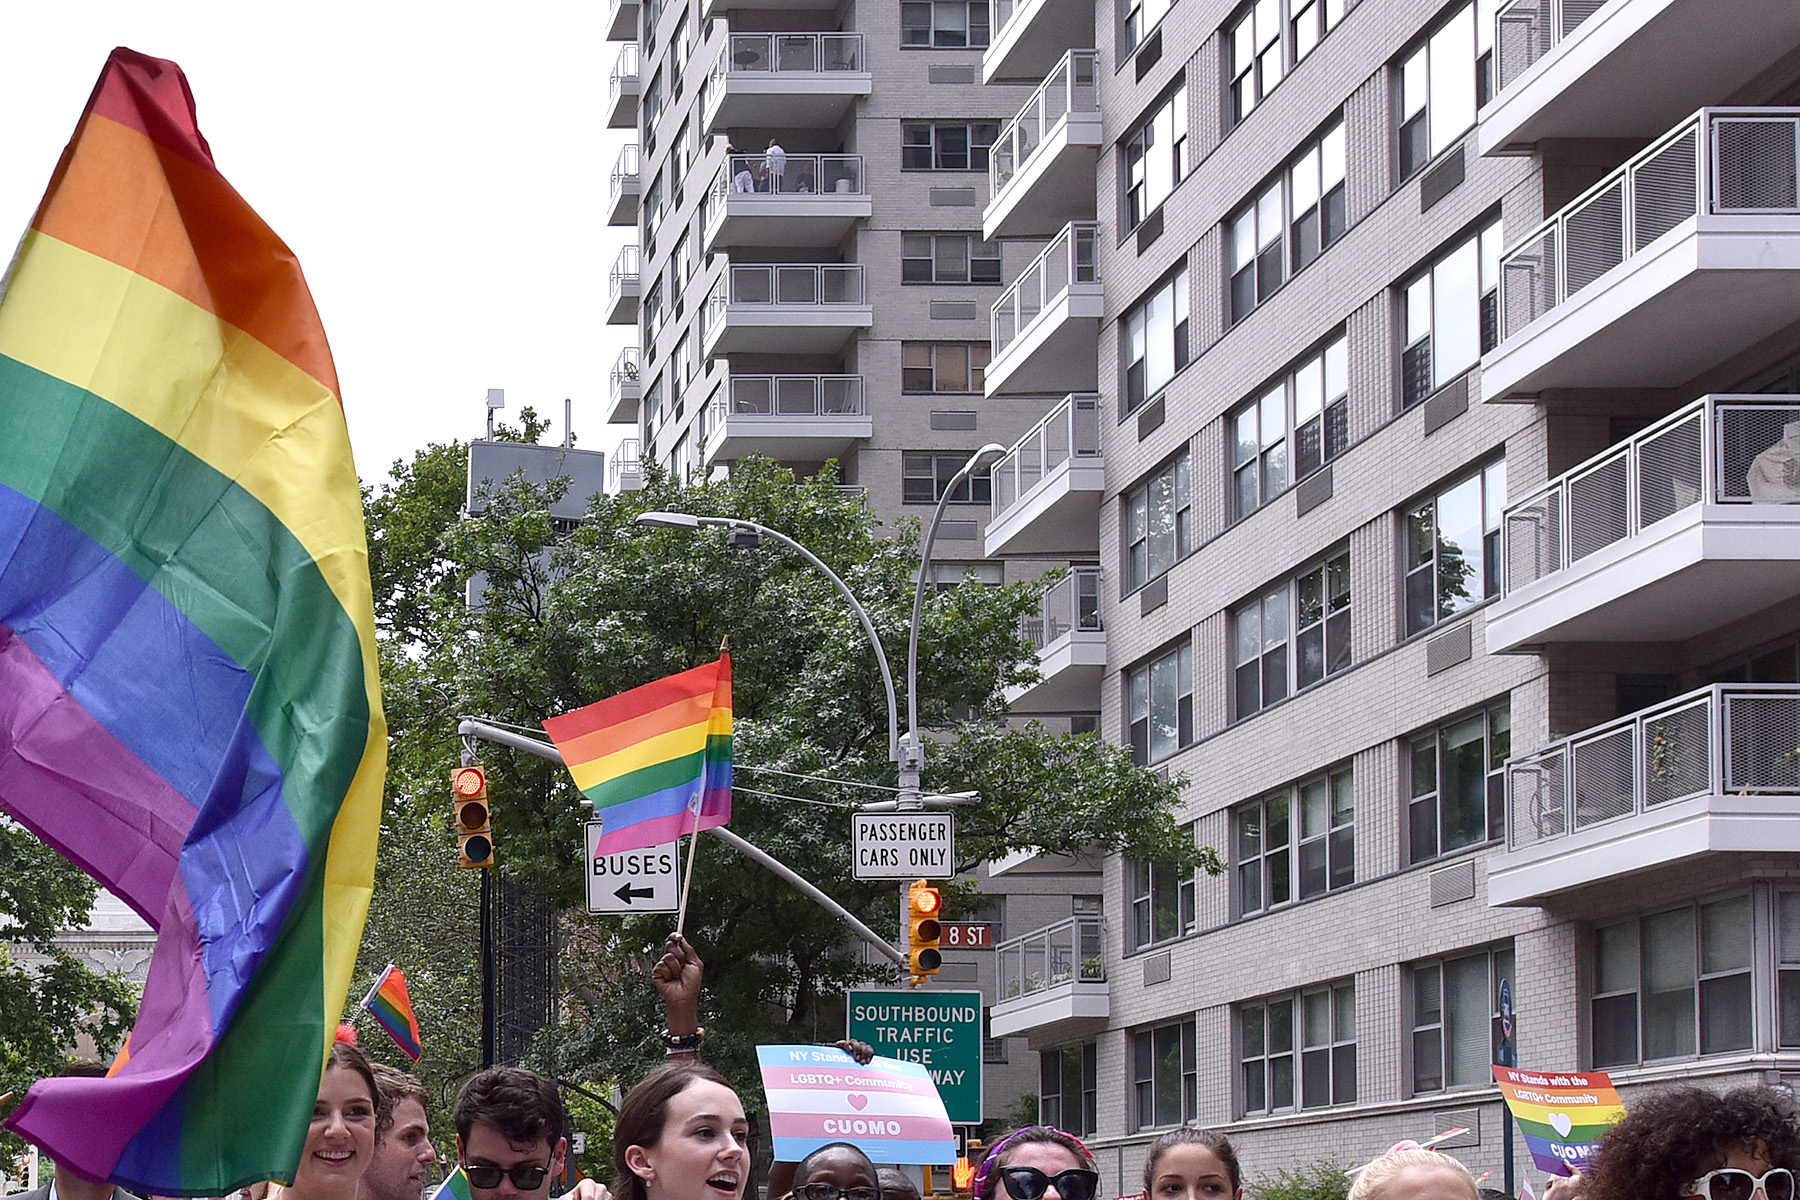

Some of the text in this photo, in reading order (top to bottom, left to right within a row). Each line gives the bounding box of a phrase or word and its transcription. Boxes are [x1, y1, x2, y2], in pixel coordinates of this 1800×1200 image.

[860, 823, 947, 842] PASSENGER
[593, 854, 672, 876] BUSES
[860, 848, 947, 866] CARS ONLY
[949, 926, 985, 945] 8 ST
[854, 1006, 976, 1023] SOUTHBOUND
[876, 1027, 954, 1044] TRAFFIC
[789, 1051, 807, 1061] NY
[896, 1048, 932, 1064] USE
[789, 1073, 841, 1085] LGBTQ+
[845, 1075, 913, 1092] Community
[1508, 1071, 1589, 1086] NY Stands with the
[1513, 1088, 1599, 1106] LGBTQ+ Community
[823, 1119, 901, 1136] CUOMO
